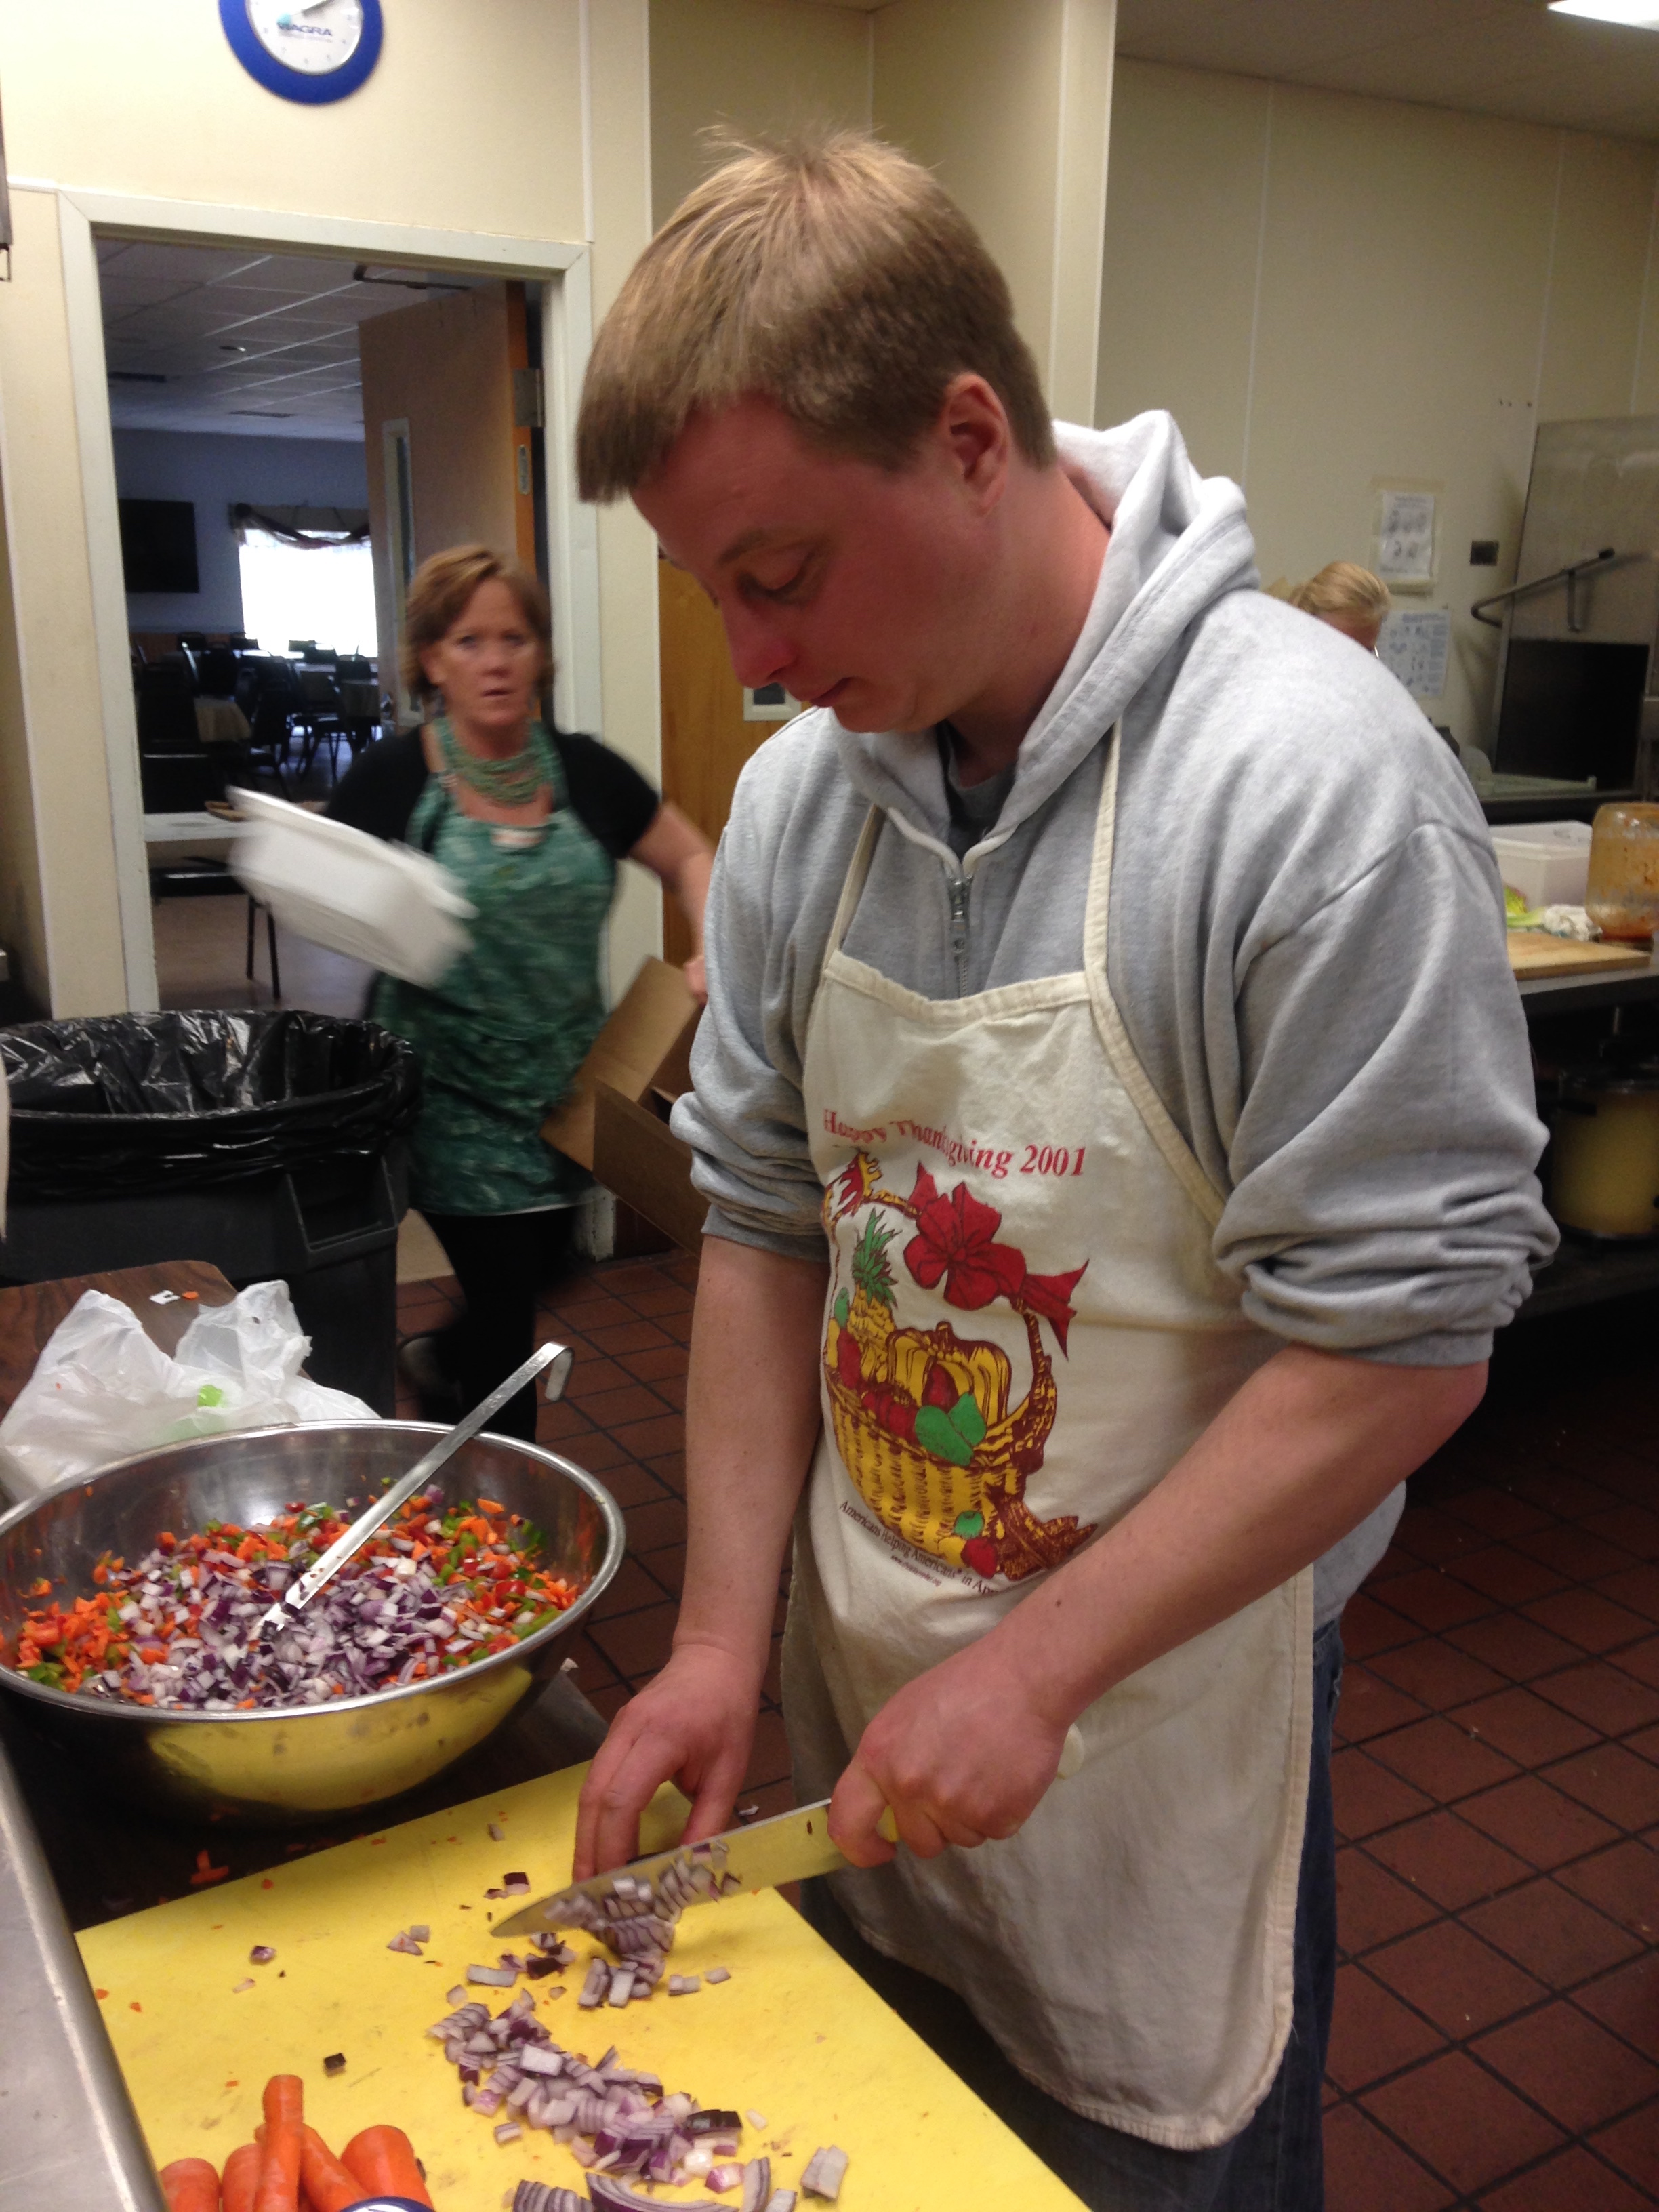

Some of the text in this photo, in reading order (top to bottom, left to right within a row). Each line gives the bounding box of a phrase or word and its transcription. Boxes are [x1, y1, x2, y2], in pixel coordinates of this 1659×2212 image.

[1019, 1143, 1086, 1177] 2001
[839, 1500, 881, 1538] Americans
[882, 1528, 912, 1559] Helping
[961, 1576, 972, 1586] in
